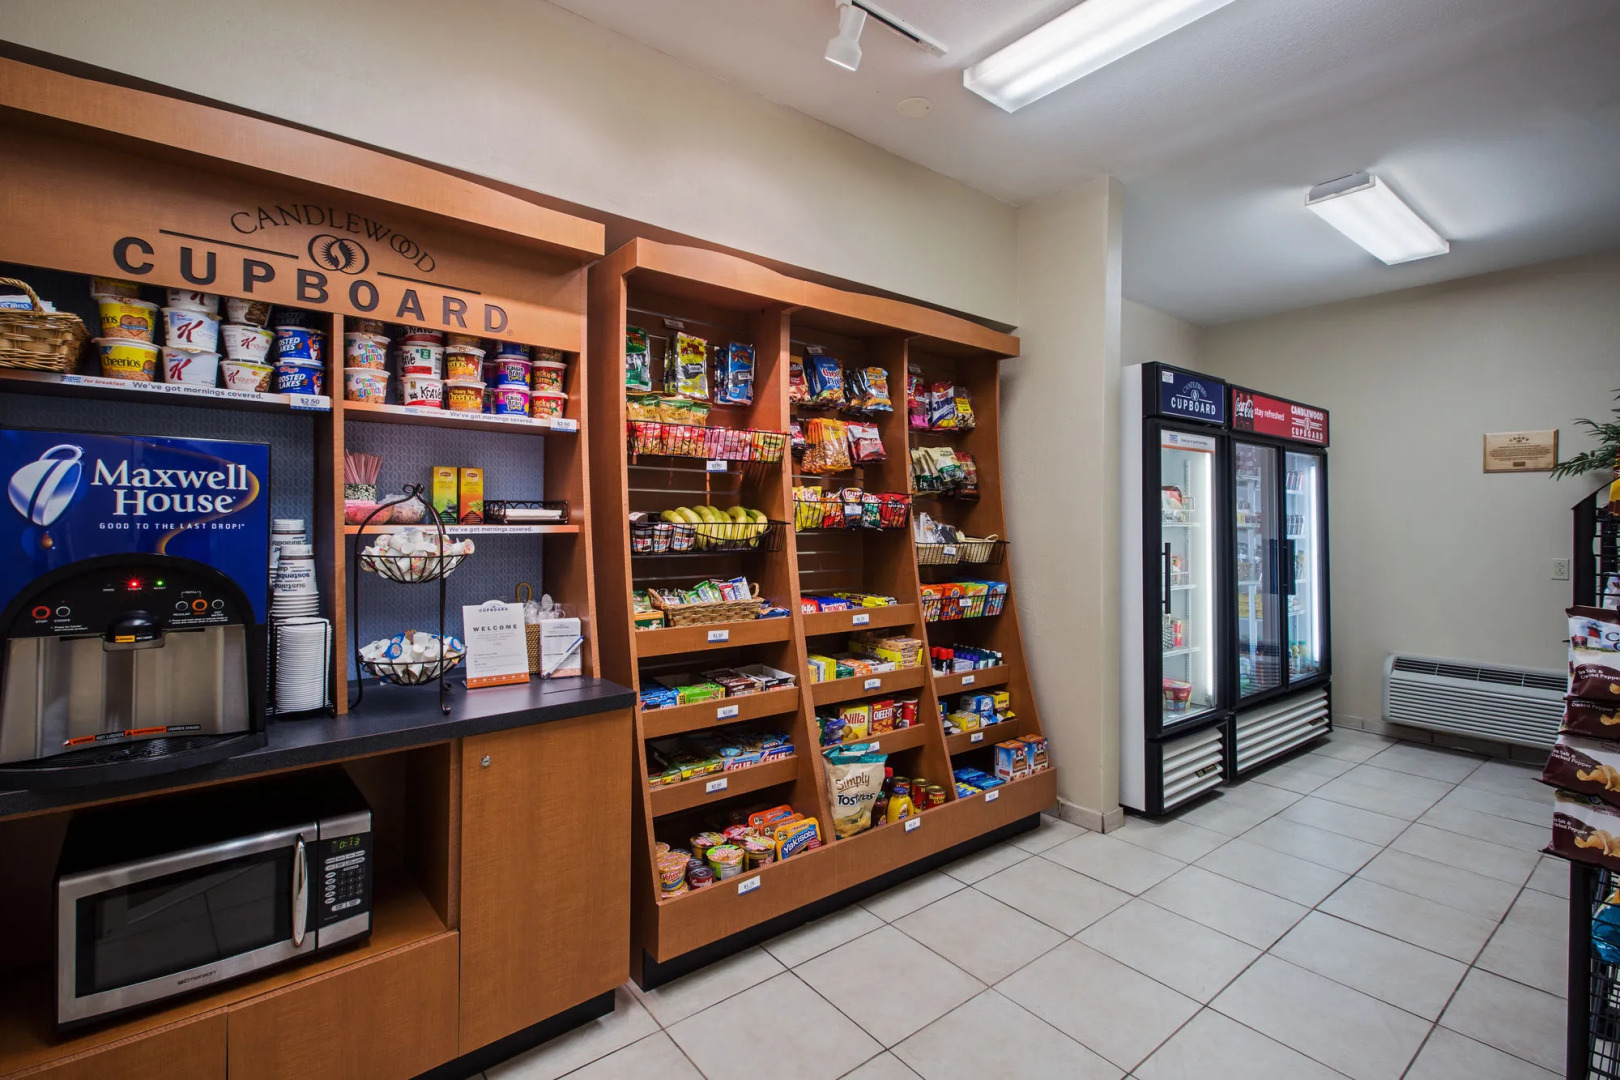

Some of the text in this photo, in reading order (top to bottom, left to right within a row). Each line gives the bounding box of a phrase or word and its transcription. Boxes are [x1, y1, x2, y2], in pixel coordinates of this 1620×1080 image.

[229, 203, 436, 273] CANDLEWOOD
[112, 236, 508, 333] CUPBOARD
[177, 320, 204, 343] K
[241, 336, 256, 349] K
[104, 356, 141, 369] Cheerios
[361, 353, 383, 363] Crunch
[169, 358, 192, 381] K
[228, 370, 240, 384] K
[133, 382, 162, 390] We've
[165, 385, 182, 393] got
[183, 386, 225, 397] mornings
[227, 391, 264, 399] covered.
[359, 388, 381, 398] Crunch
[1183, 380, 1208, 398] CANDLEWOOD
[1171, 397, 1216, 415] CUPBOARD
[1291, 405, 1323, 421] CANDLEWOOD
[482, 414, 509, 423] mornings
[1254, 407, 1285, 421] stay refreshed
[1291, 426, 1323, 441] CUPBOARD
[91, 458, 248, 491] Maxwell
[113, 489, 233, 516] House
[481, 526, 508, 534] mornings
[473, 624, 517, 632] WELCOME
[1591, 704, 1613, 712] Pepper
[844, 713, 865, 724] Nilla
[1571, 758, 1592, 768] Pepper
[836, 772, 870, 791] Simply
[1567, 825, 1588, 835] Pepper
[783, 829, 815, 854] Yakisoba
